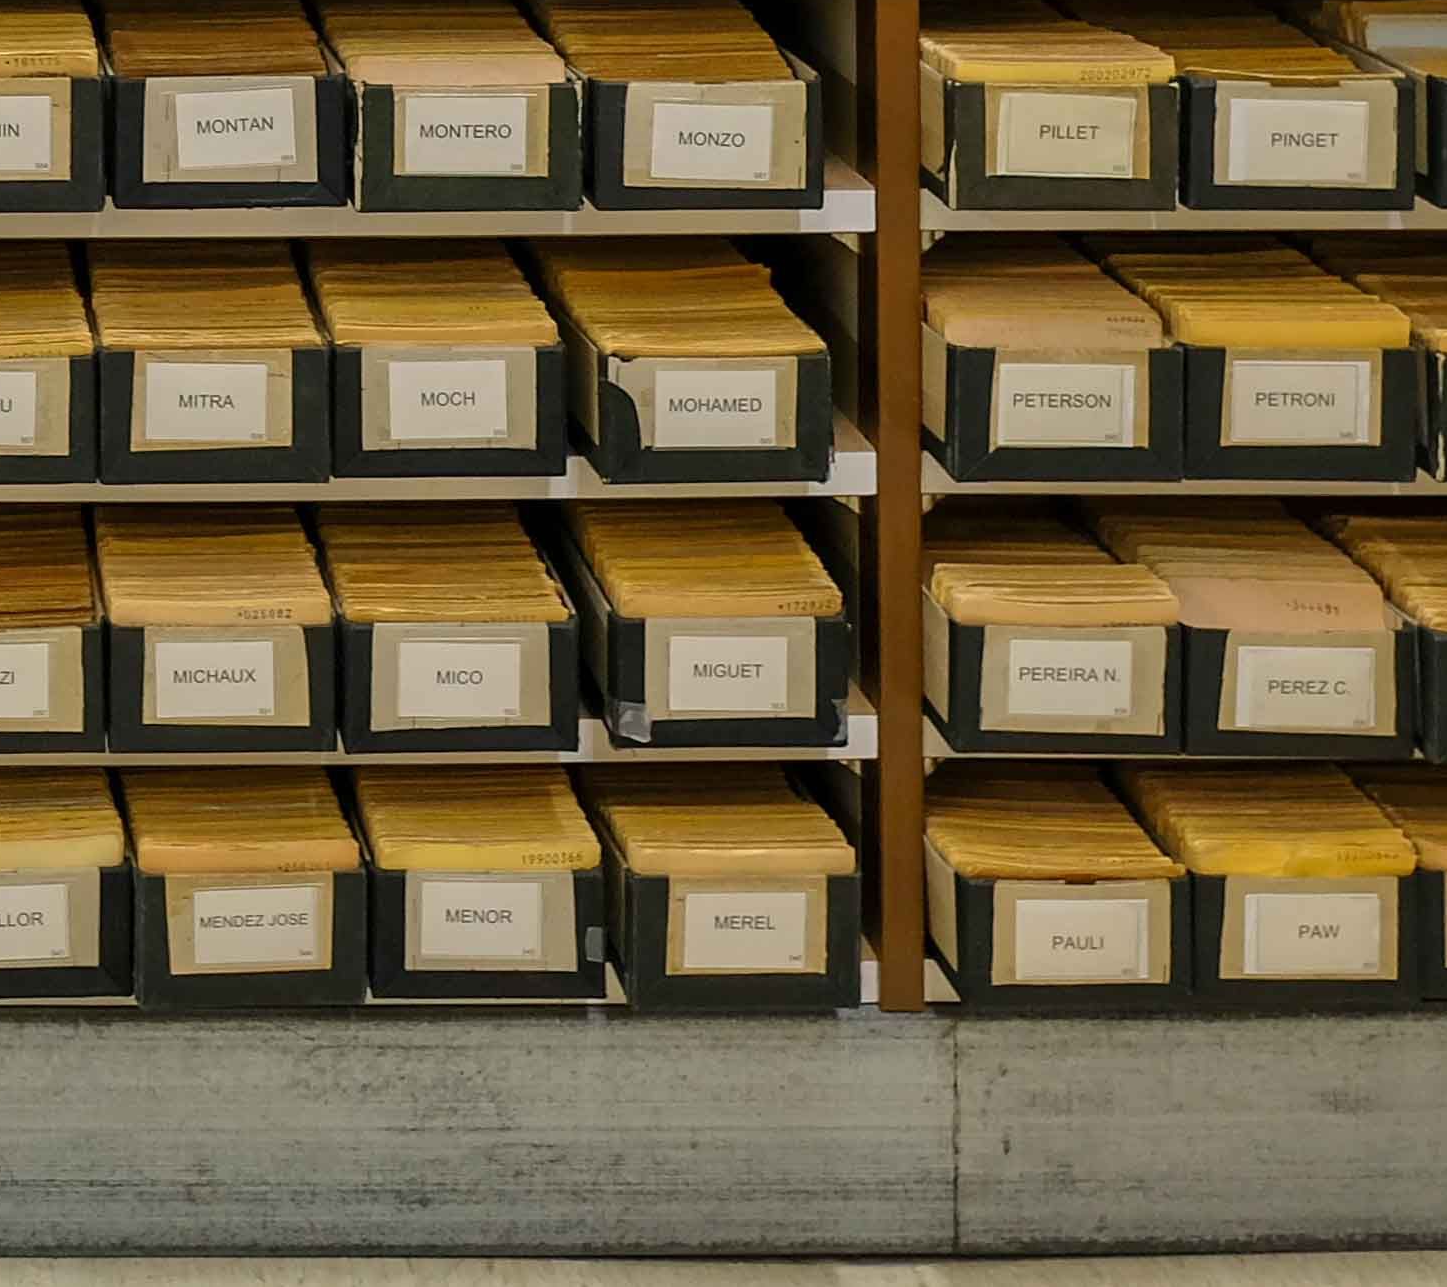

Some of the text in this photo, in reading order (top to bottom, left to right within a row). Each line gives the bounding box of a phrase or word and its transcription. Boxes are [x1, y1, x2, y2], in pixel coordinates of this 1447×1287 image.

[419, 123, 512, 139] MONTERO
[1039, 124, 1100, 140] PILLET
[178, 394, 235, 409] MITRA
[1012, 392, 1112, 409] PETERSON
[173, 668, 257, 684] MICHAUX
[1018, 666, 1099, 683] PEREIRA
[445, 908, 513, 924] MENOR
[714, 915, 776, 931] MEREL
[1051, 935, 1104, 951] PAULI
